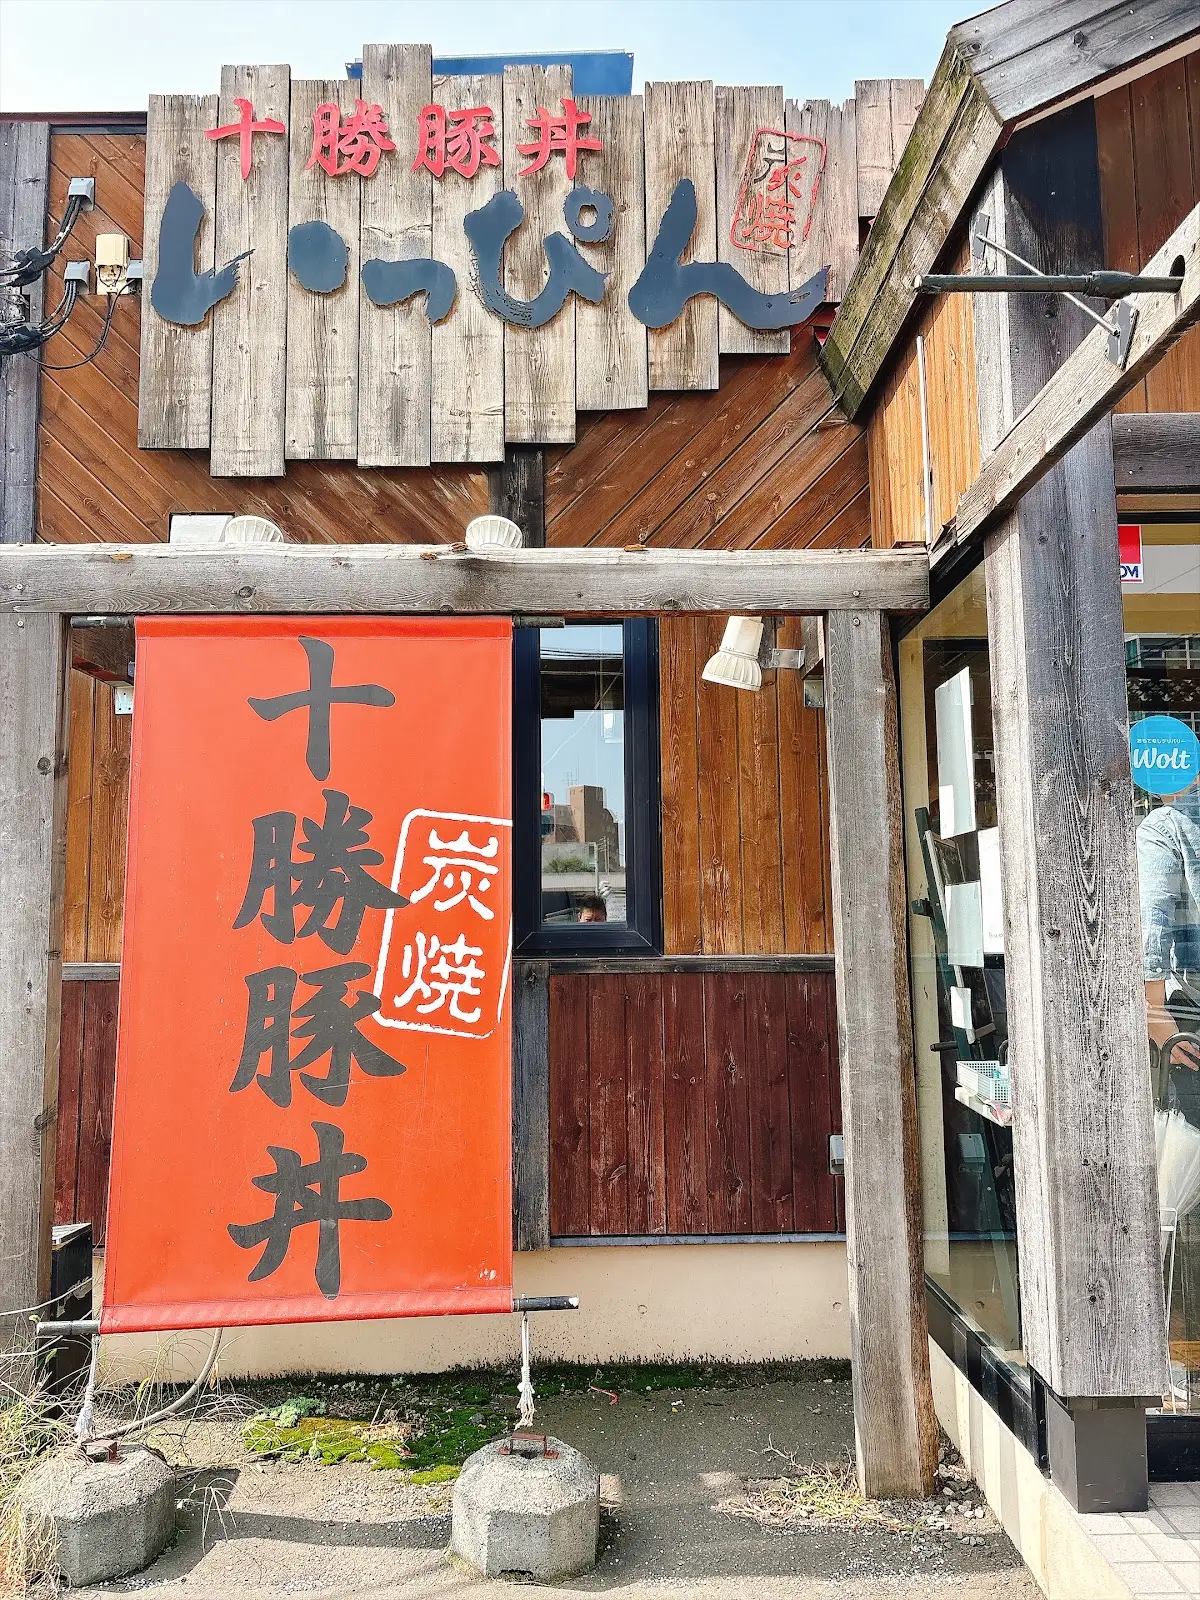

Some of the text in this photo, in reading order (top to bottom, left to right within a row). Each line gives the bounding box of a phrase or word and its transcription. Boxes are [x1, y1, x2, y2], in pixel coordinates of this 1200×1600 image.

[204, 98, 604, 182] 十勝豚丼
[150, 179, 832, 330] いっぴん
[1133, 747, 1191, 770] Wolt
[227, 635, 410, 1300] 十勝豚丼
[393, 827, 500, 1024] 炭焼
